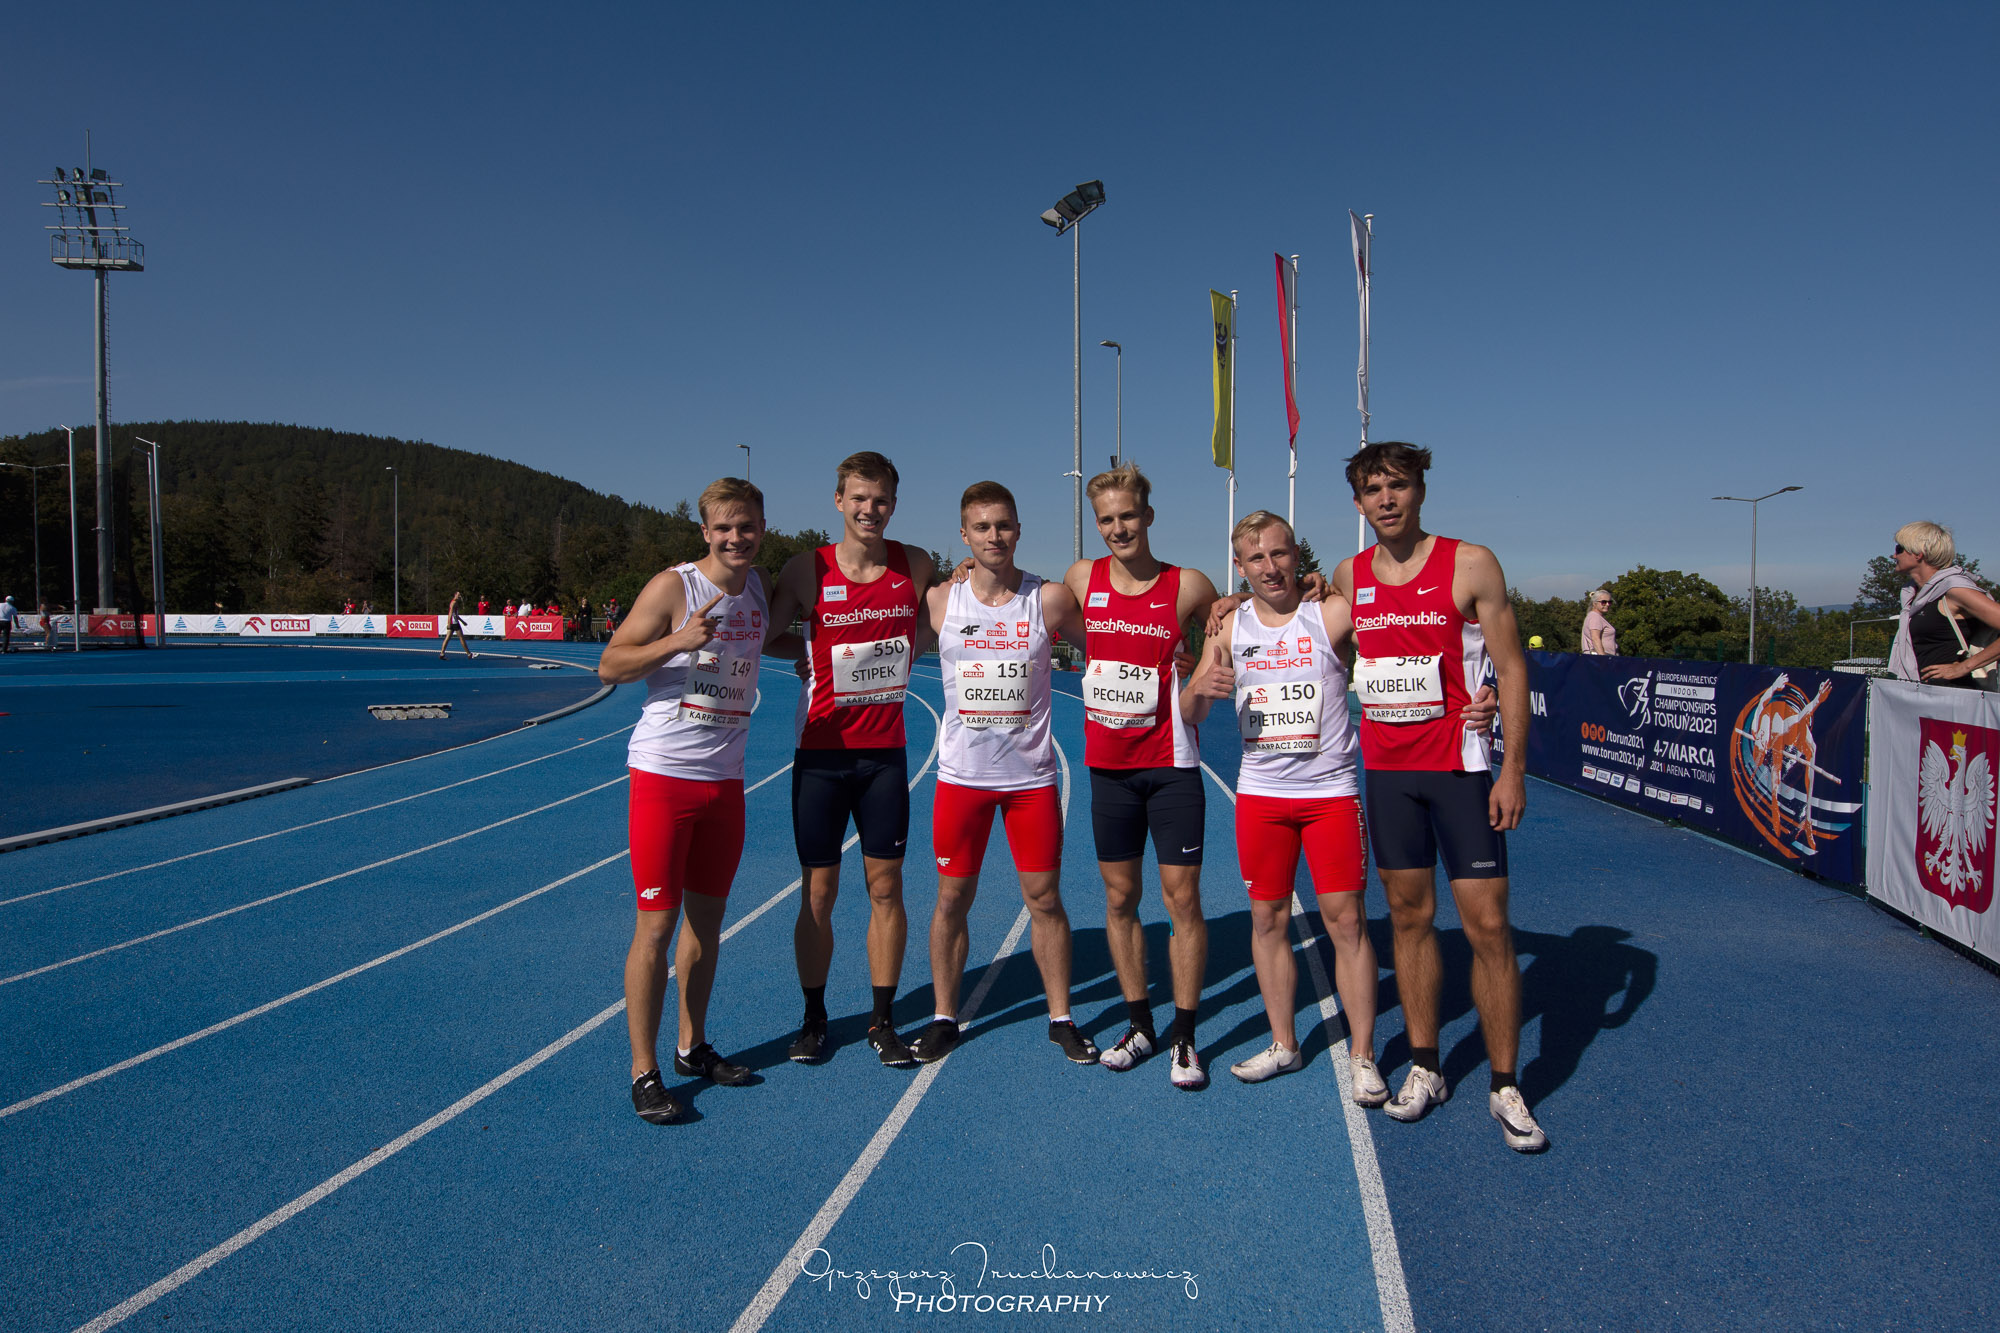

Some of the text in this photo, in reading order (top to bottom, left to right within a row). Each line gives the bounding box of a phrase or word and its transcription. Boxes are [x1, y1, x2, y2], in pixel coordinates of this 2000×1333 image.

[822, 605, 914, 625] CzechRepublic
[1356, 611, 1447, 629] CzechRepublic
[272, 620, 308, 631] ORLEN
[410, 622, 431, 630] ORLEN
[531, 622, 551, 631] ORLEN
[960, 625, 980, 635] 4F
[1085, 618, 1171, 639] CzechRepublic
[713, 631, 760, 641] POLSKA
[874, 640, 904, 657] 550
[964, 640, 1029, 650] POLSKA
[1242, 646, 1261, 657] 4F
[731, 661, 751, 677] 149
[997, 663, 1028, 678] 151
[1246, 657, 1312, 671] POLSKA
[852, 665, 896, 682] STIPEK
[1119, 665, 1152, 681] 549
[1662, 673, 1717, 685] EUROPEAN ATHLETICS
[694, 681, 746, 700] WDOWIK
[1366, 677, 1427, 693] KUBELIK
[1671, 687, 1698, 696] INDOOR
[846, 695, 883, 704] KARPACZ
[886, 691, 904, 700] 2020
[965, 688, 1025, 701] GRZELAK
[1093, 687, 1144, 703] PECHAR
[1280, 684, 1315, 701] 150
[1371, 708, 1432, 718] KARPACZ 2020
[1655, 697, 1716, 715] CHAMPIONSHIPS
[690, 711, 726, 724] KARPACZ
[1126, 718, 1145, 726] 2020
[1249, 711, 1315, 728] PIETRUSA
[1294, 741, 1312, 749] 2020
[1582, 743, 1645, 771] www.torun2021.pl
[1650, 760, 1715, 784] 2021 ARENA TORUŃ
[641, 887, 662, 900] 4F
